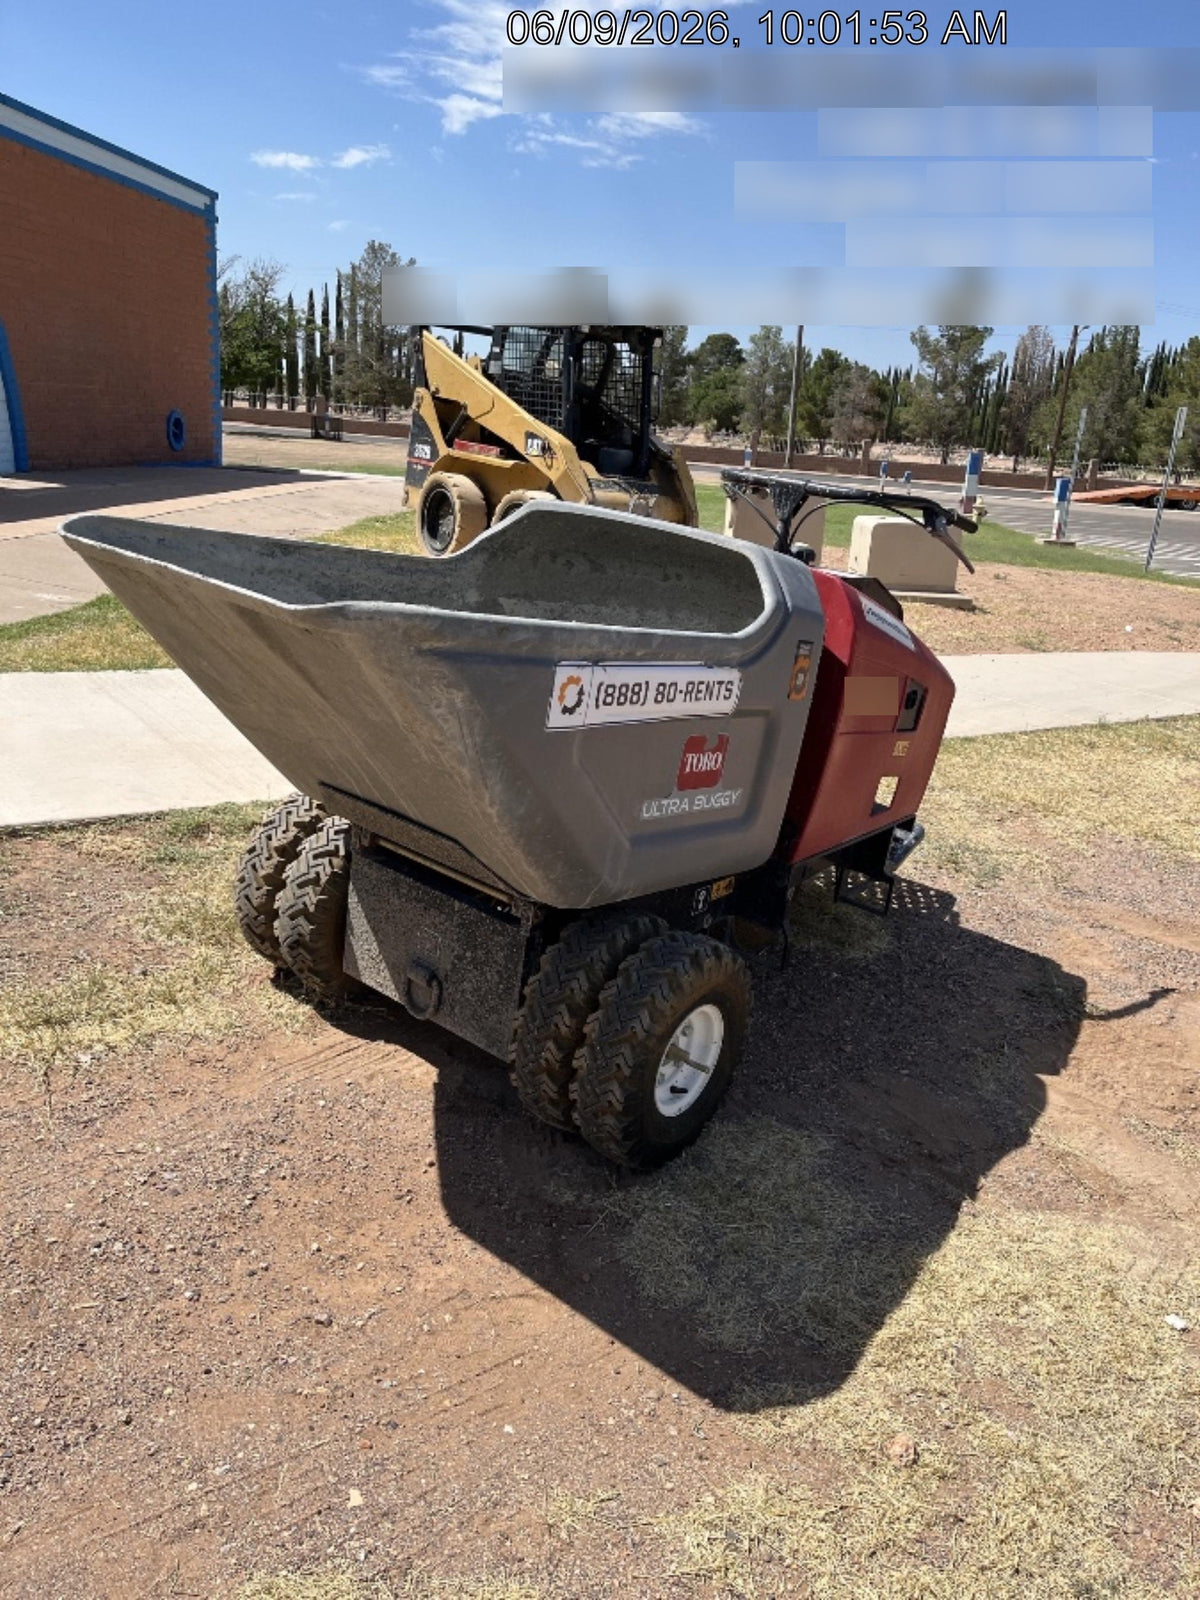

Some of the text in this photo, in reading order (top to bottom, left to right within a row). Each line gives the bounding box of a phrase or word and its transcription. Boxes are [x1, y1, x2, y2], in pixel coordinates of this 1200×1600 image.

[595, 680, 734, 709] (888) 80-RENTS
[684, 751, 723, 774] TORO
[642, 788, 743, 818] ULTRA BUGGY
